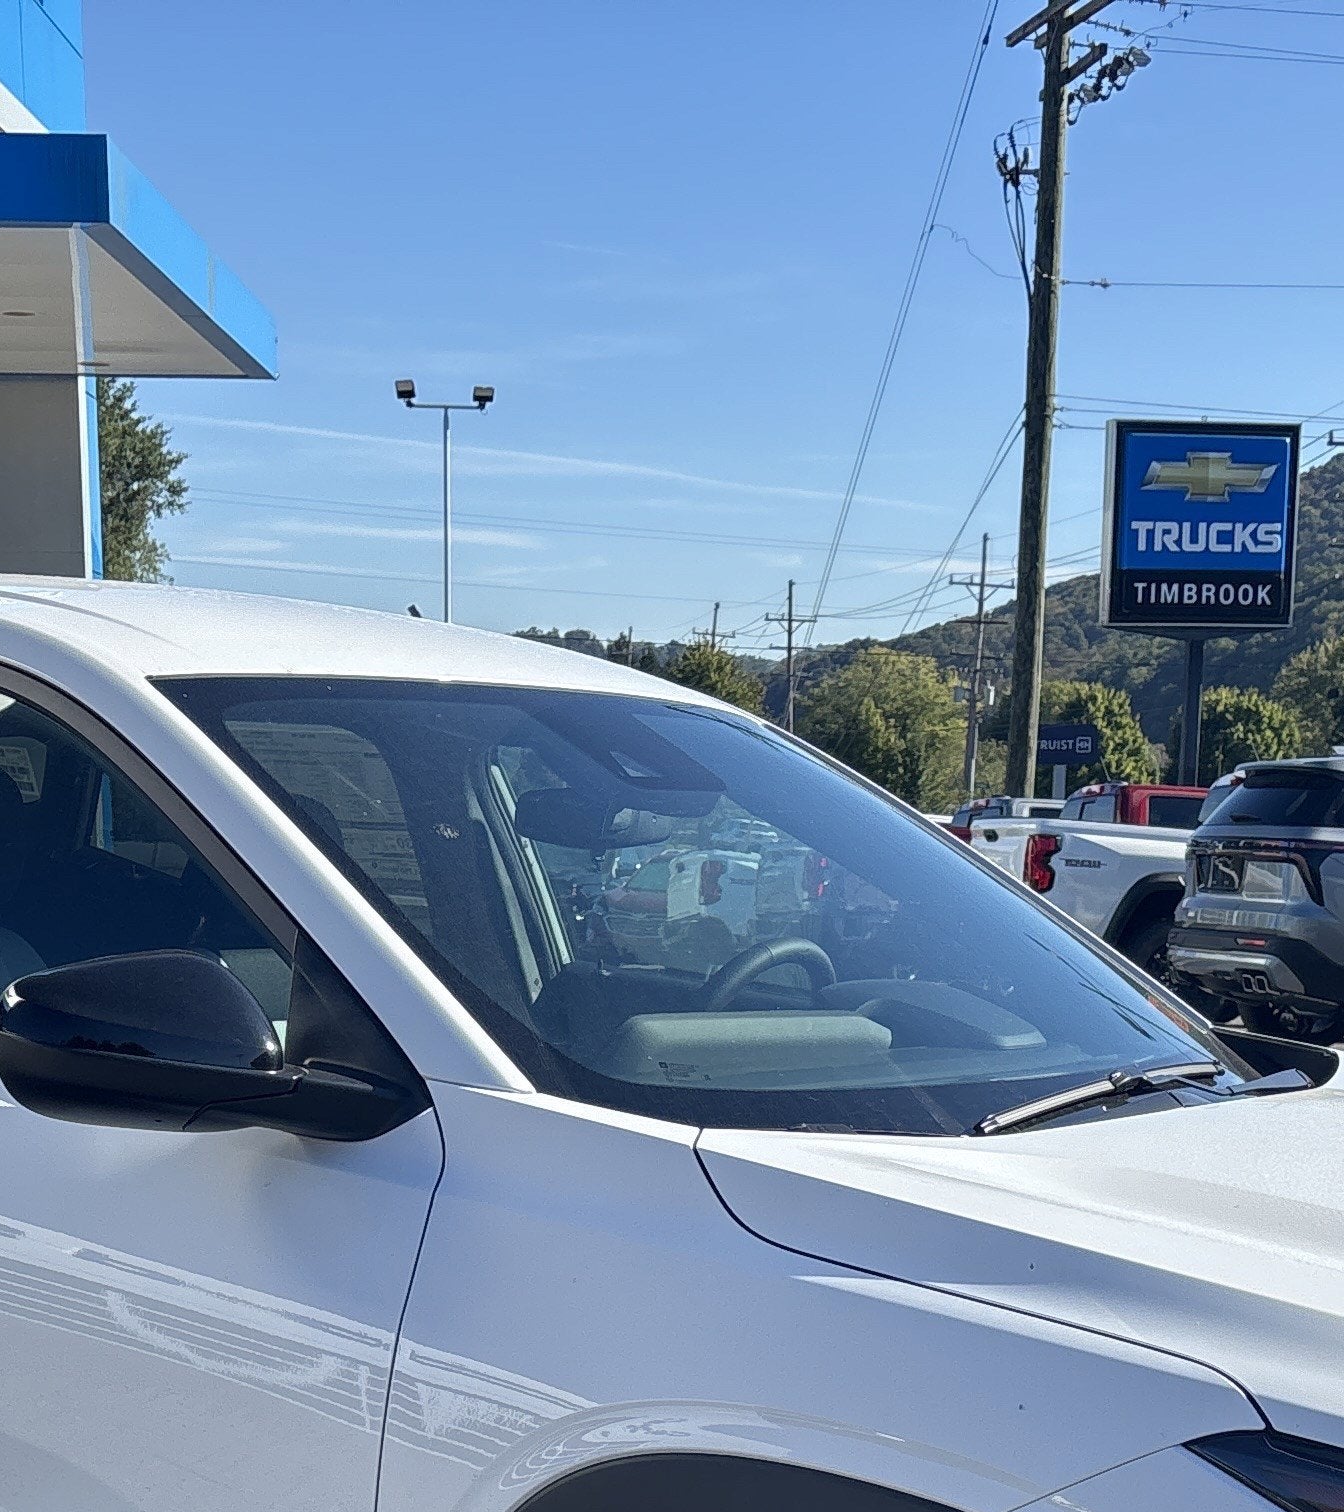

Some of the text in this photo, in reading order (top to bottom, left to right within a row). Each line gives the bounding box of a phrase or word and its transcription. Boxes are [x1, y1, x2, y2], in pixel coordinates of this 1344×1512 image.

[1130, 520, 1282, 553] TRUCKS
[1133, 582, 1273, 606] TIMBROOK
[1038, 739, 1074, 750] RUIST
